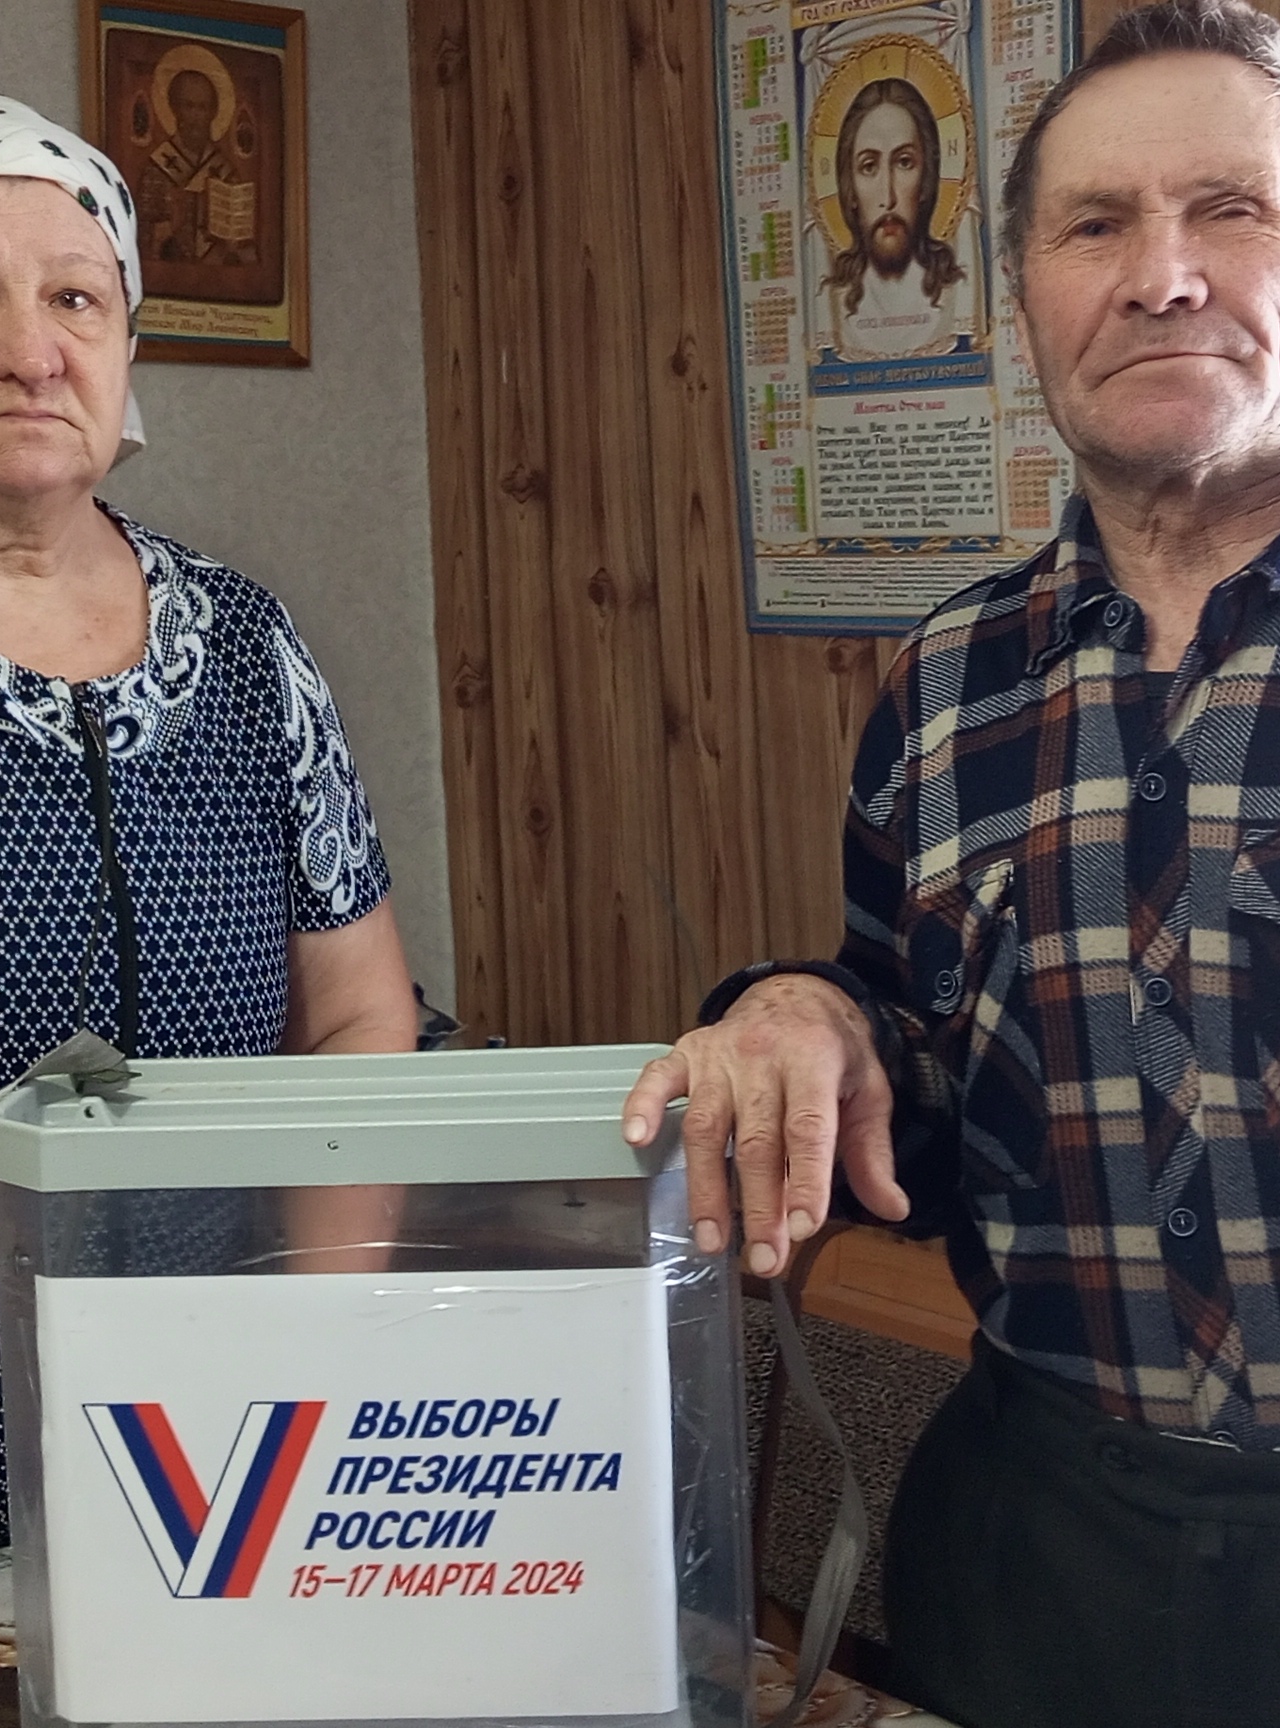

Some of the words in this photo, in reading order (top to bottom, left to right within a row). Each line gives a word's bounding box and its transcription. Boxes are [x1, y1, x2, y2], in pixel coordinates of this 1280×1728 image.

[349, 1398, 560, 1439] ВЫБОРЫ
[327, 1452, 622, 1498] ПРЕЗИДЕНТА
[306, 1510, 496, 1550] РОССИИ
[386, 1562, 495, 1597] МАРТА
[503, 1561, 584, 1596] 2024
